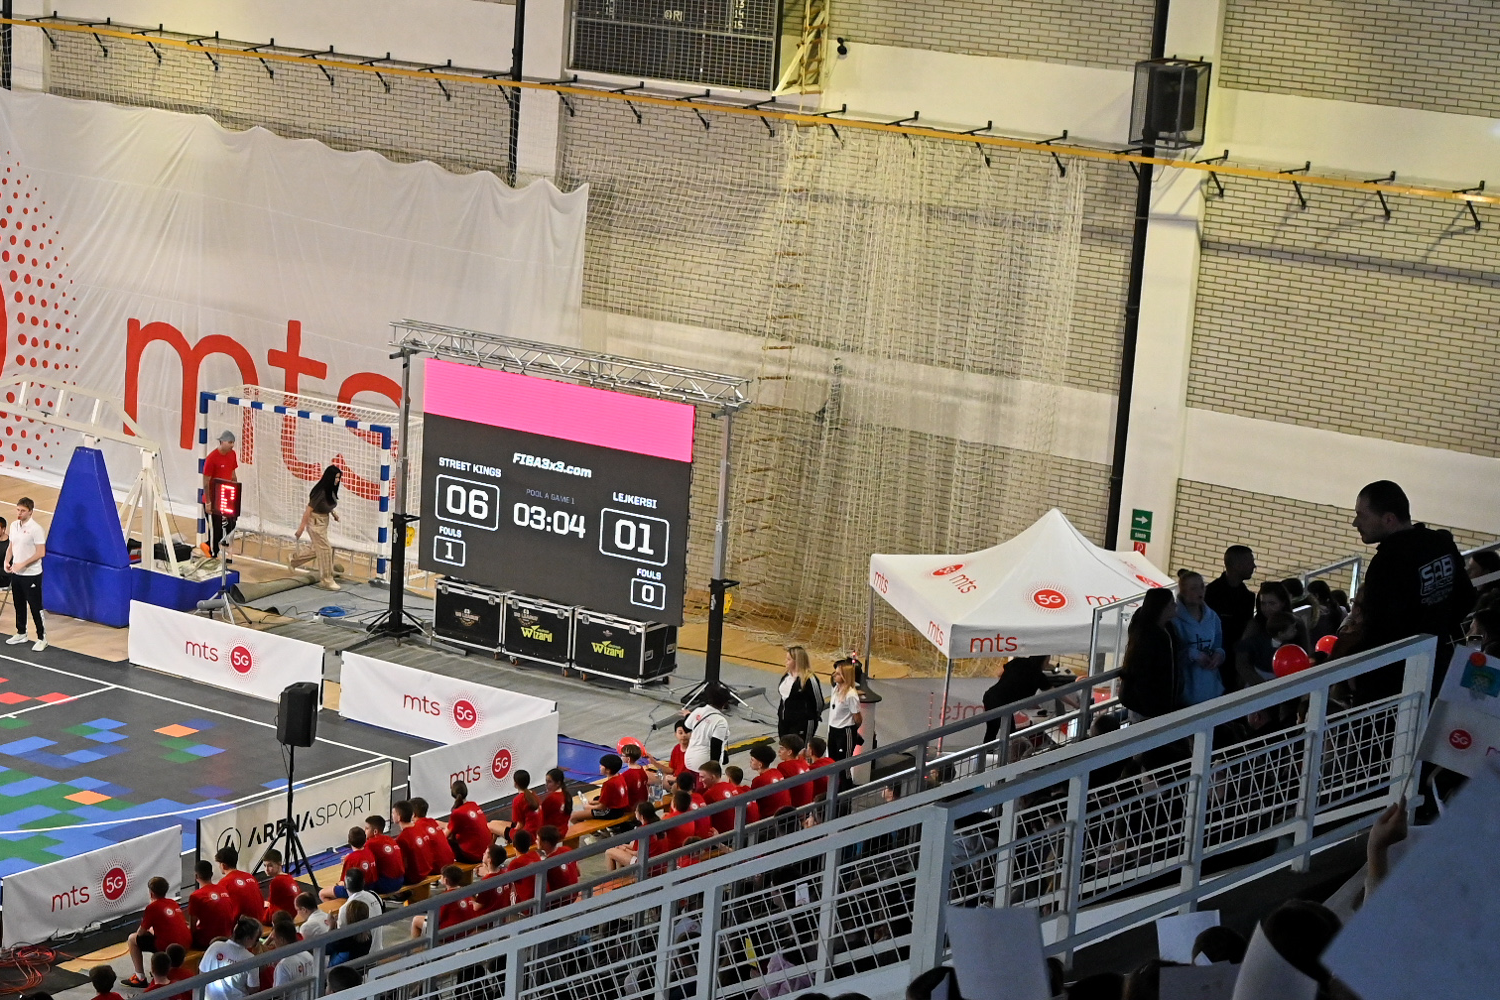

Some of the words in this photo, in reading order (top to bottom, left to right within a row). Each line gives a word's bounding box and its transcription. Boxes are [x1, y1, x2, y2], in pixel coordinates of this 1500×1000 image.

[123, 318, 411, 502] mts
[439, 456, 472, 472] STREET
[473, 464, 502, 478] KINGS
[512, 452, 592, 478] FIBA3x3.com
[446, 484, 489, 520] 06
[439, 525, 462, 538] FOULS
[513, 502, 586, 539] 03:04
[614, 518, 654, 556] 01
[444, 542, 454, 560] 1
[636, 567, 662, 581] FOULS
[873, 570, 890, 595] mts
[949, 572, 978, 595] mts
[641, 584, 655, 603] 0
[1037, 594, 1061, 605] 5G
[520, 626, 553, 643] Wizard
[926, 620, 944, 646] mts
[970, 633, 1018, 653] mts
[185, 639, 218, 662] mts
[233, 651, 250, 667] 5G
[591, 641, 625, 658] Wizard
[403, 693, 441, 716] mts
[455, 705, 474, 721] 5G
[450, 765, 481, 787] mts
[494, 756, 511, 772] 5G
[51, 884, 90, 912] mts
[106, 871, 124, 892] 5G
